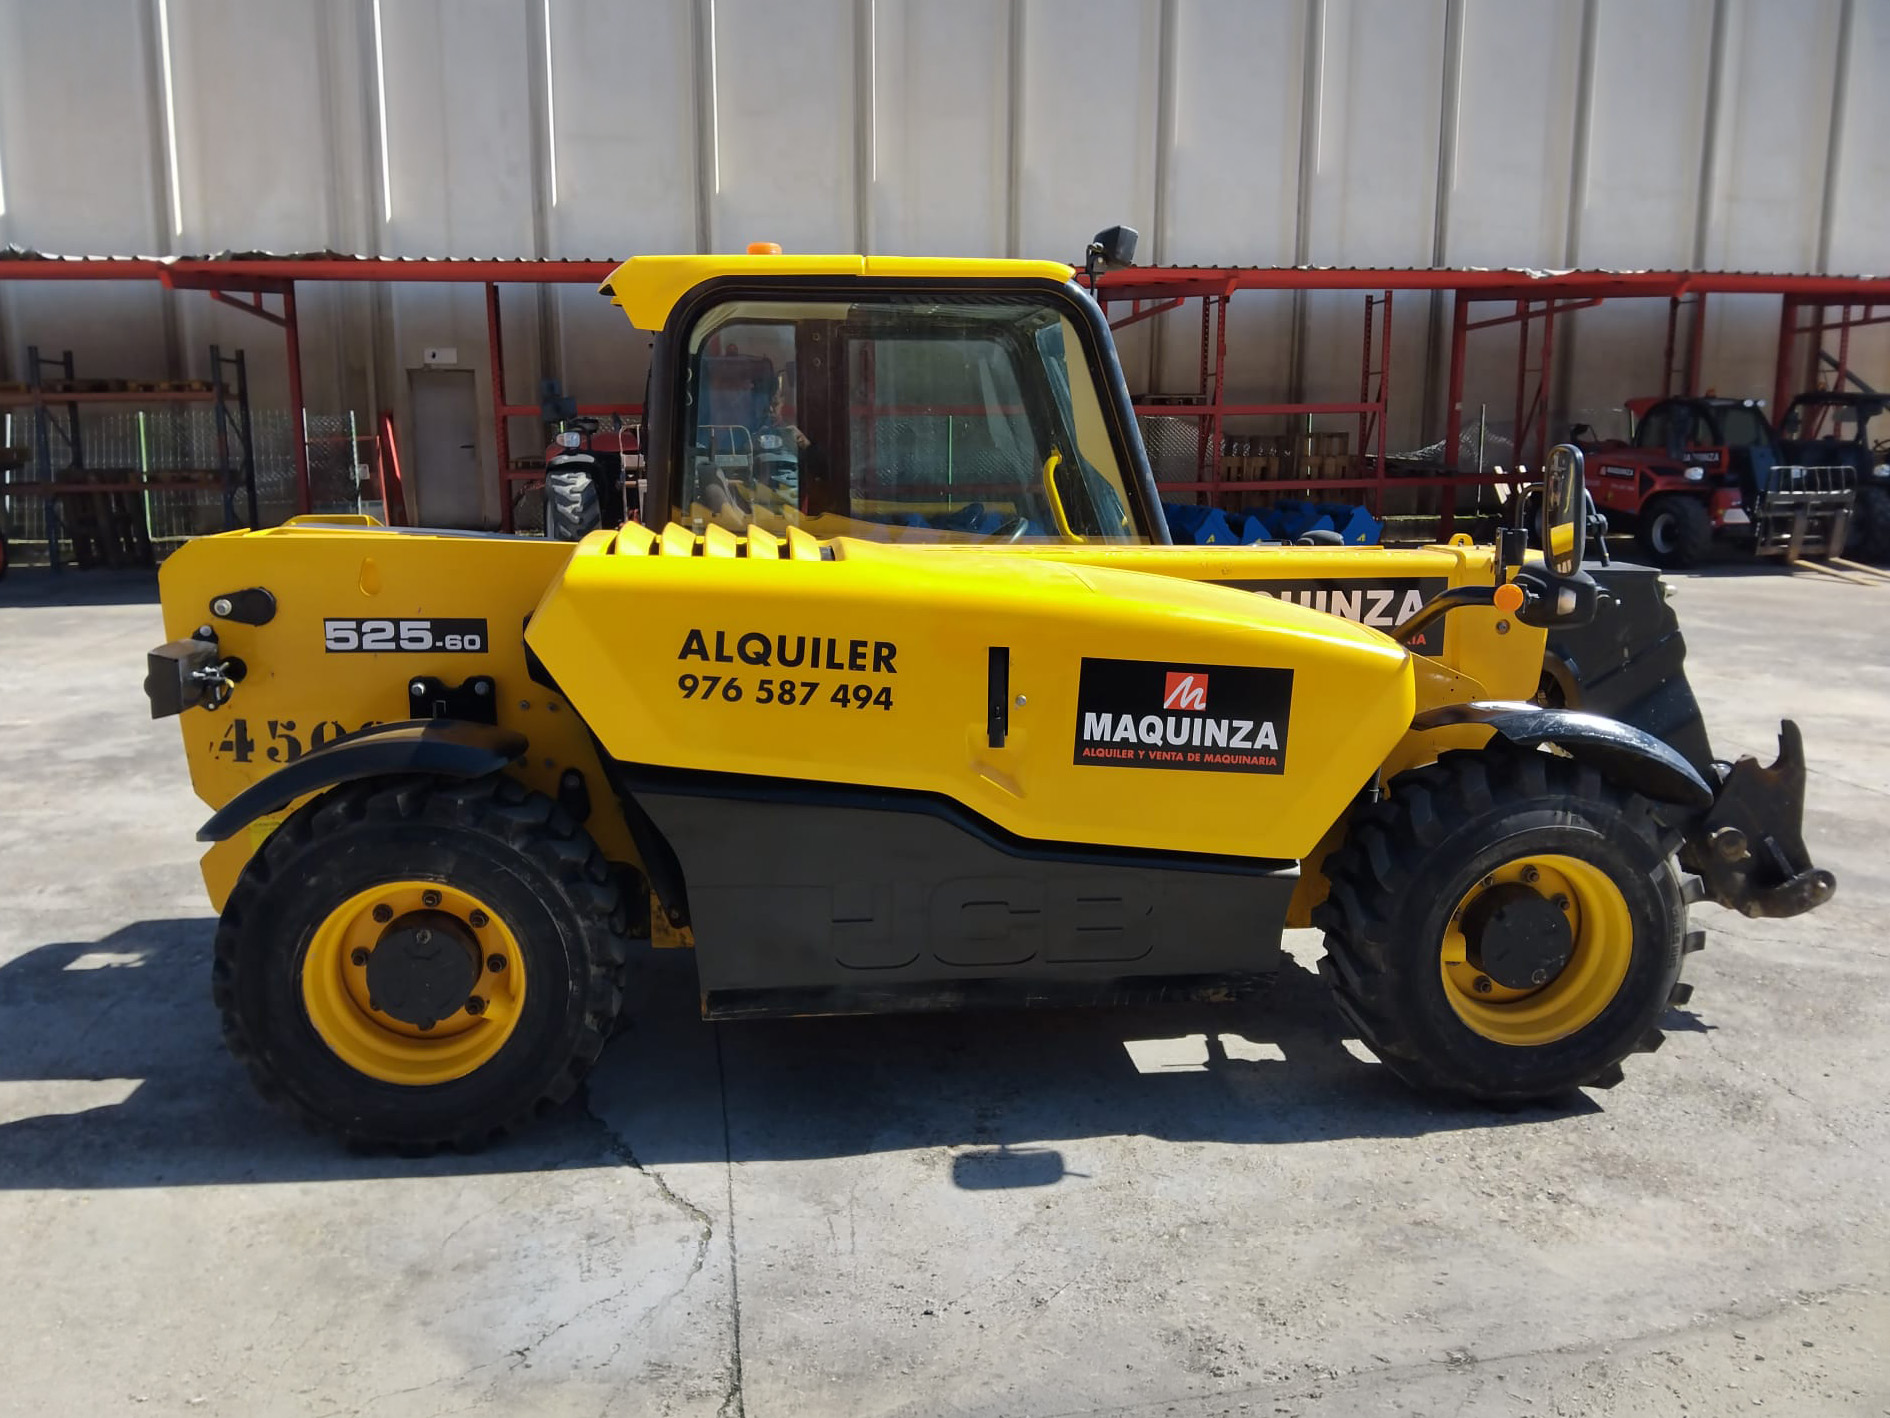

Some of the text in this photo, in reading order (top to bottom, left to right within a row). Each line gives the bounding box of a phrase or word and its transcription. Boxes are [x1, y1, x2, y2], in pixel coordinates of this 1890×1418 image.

[325, 620, 481, 651] 525-60
[678, 629, 898, 674] ALQUILER
[678, 673, 894, 711] 976 587 494
[219, 718, 384, 763] 450
[1083, 712, 1279, 750] MAQUINZA
[1082, 747, 1277, 766] ALQUILER Y VENTA DE MAQUINARIA
[831, 876, 1153, 970] JCB
